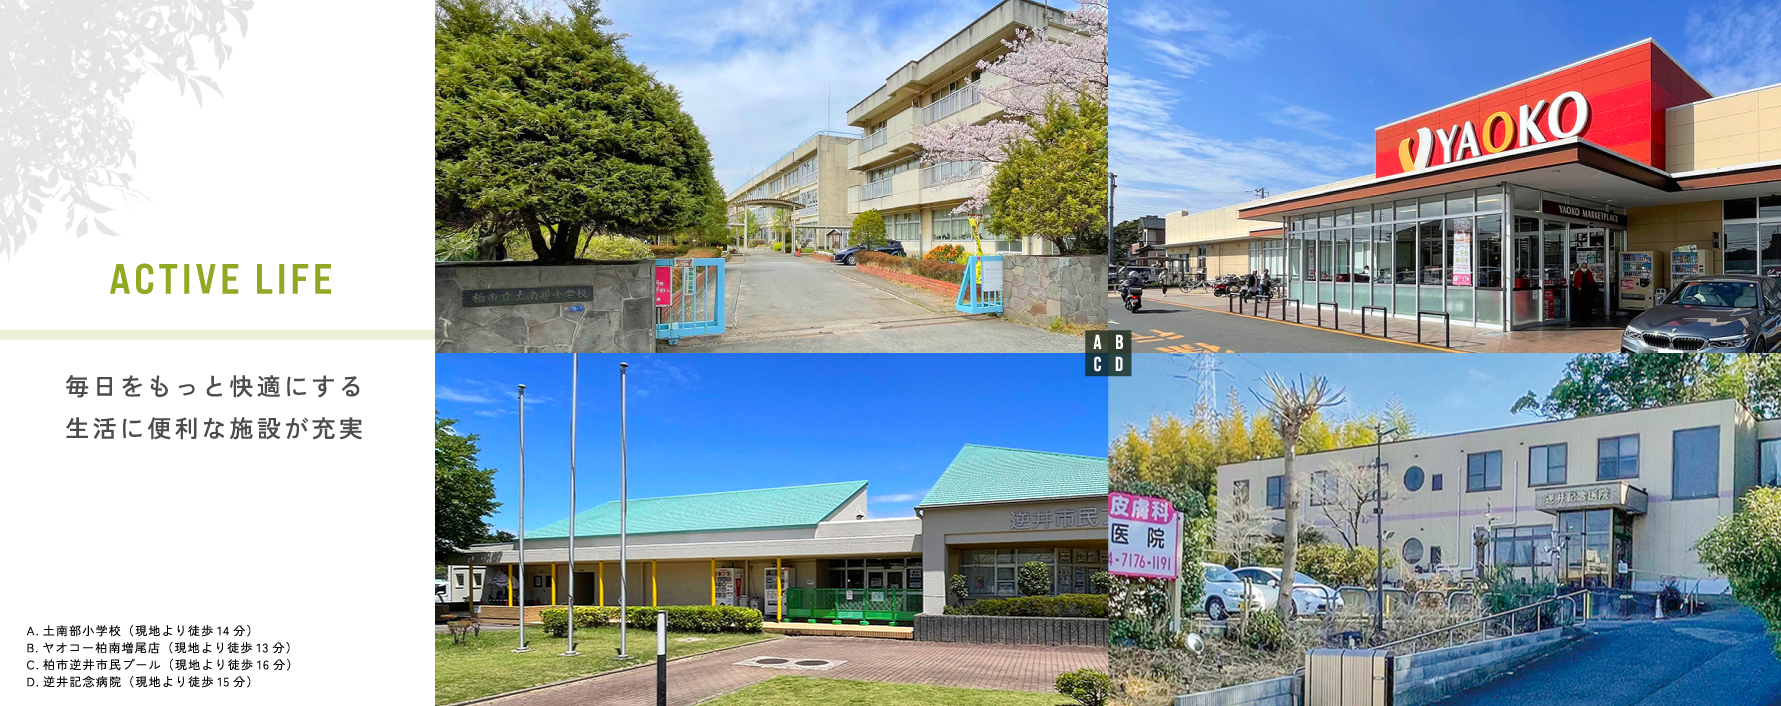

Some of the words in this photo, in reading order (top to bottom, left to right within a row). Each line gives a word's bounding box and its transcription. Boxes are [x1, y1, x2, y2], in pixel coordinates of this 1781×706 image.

[1436, 91, 1591, 163] YAOKO
[1559, 204, 1580, 217] YAOKO
[1582, 209, 1619, 223] MARKETPLACE
[472, 289, 588, 303] 柏市立土南部小学校
[1110, 495, 1169, 522] 皮膚科
